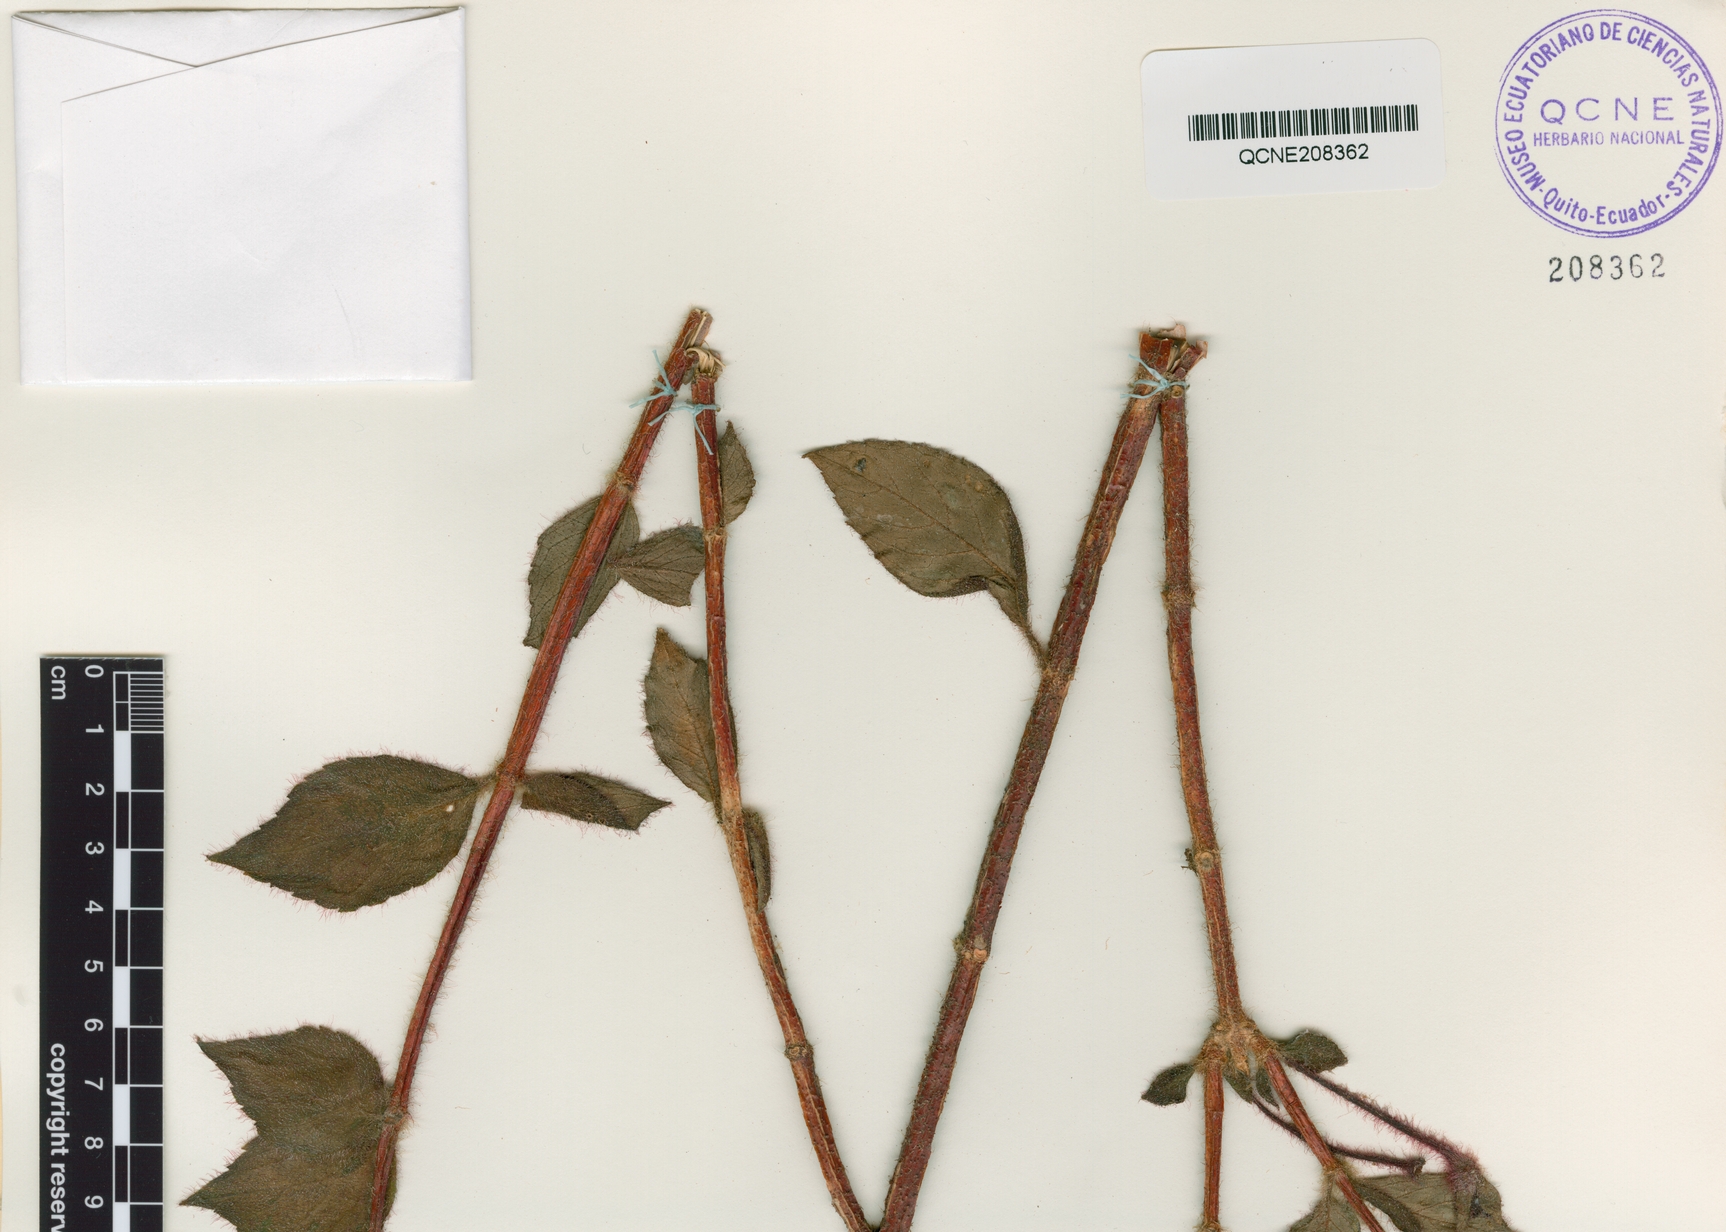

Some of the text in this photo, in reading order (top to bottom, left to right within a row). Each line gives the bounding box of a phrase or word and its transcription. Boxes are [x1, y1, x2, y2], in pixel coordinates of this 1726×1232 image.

[1503, 21, 1712, 197] MUSEO ECUATORIANO DE CIENCIAS NATURALES
[1539, 96, 1675, 126] QCNE
[1532, 129, 1686, 147] HERBARIO NACIONAL
[1238, 142, 1370, 166] QCNE208362
[1548, 252, 1666, 283] 208362
[84, 664, 105, 679] 0
[50, 665, 68, 700] cm
[85, 723, 105, 733] 1
[85, 782, 105, 796] 2
[85, 841, 105, 855] 3
[84, 900, 104, 914] 4
[84, 959, 104, 973] 5
[84, 1018, 104, 1032] 6
[84, 1077, 104, 1091] 7
[45, 1042, 71, 1156] copyright
[84, 1136, 104, 1150] 8
[84, 1195, 104, 1209] 9
